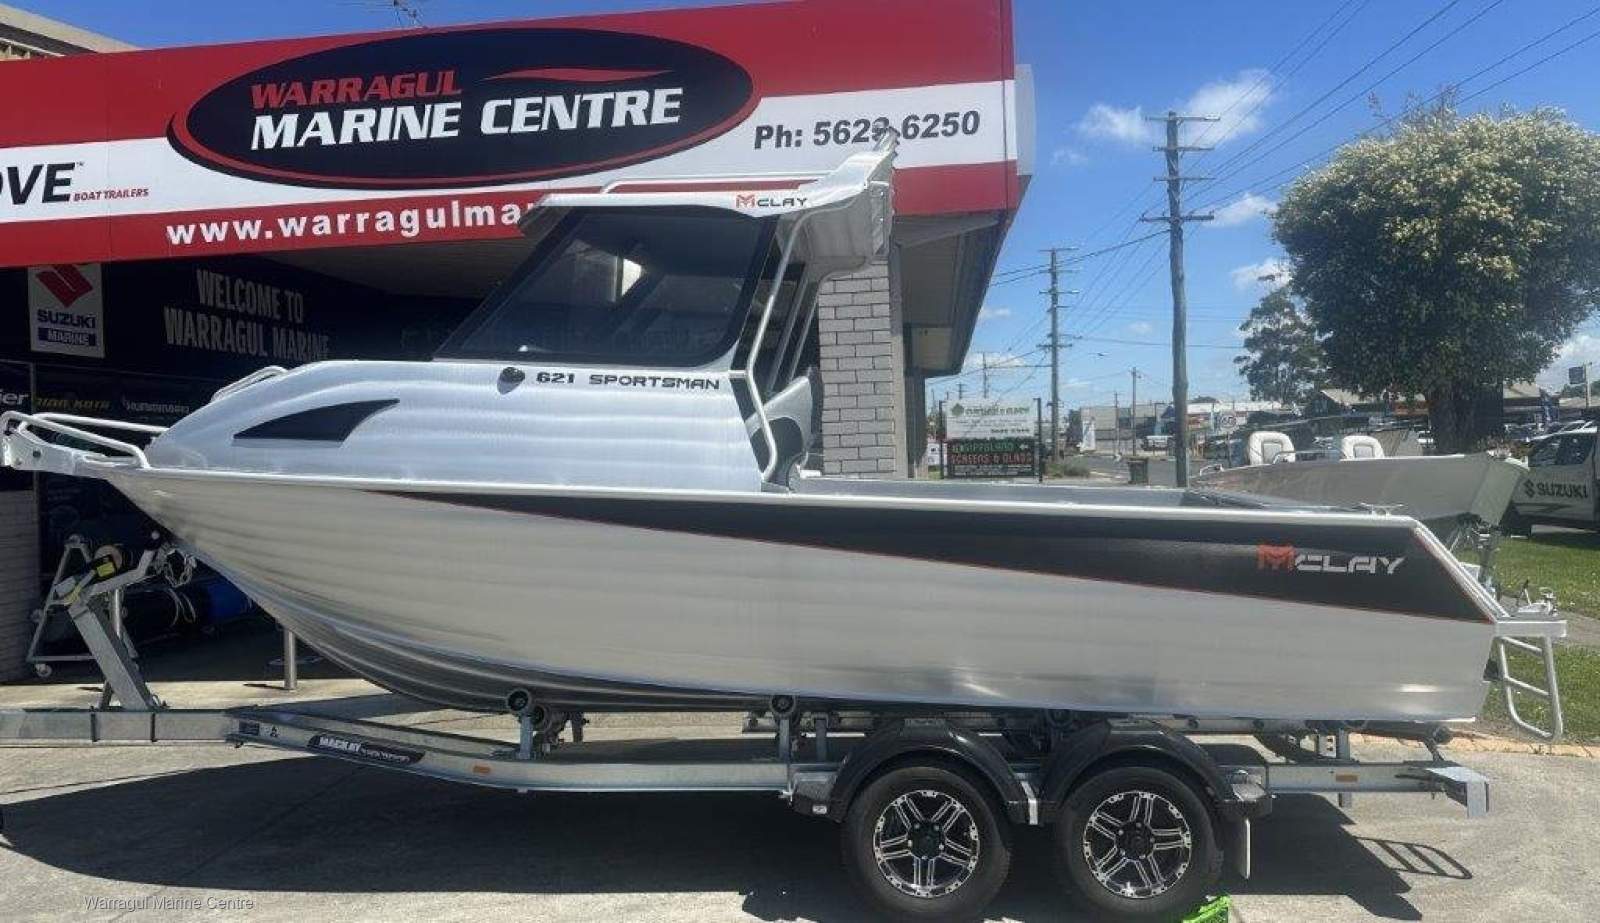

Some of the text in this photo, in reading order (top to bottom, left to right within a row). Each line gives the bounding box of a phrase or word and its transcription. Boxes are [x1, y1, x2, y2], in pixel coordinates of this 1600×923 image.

[250, 70, 463, 109] WARRAGUL
[251, 87, 683, 150] MARINE CENTRE
[754, 123, 803, 150] Ph:
[902, 110, 981, 140] 6250
[0, 162, 75, 205] VE
[74, 188, 149, 201] BOAT TRAILERS
[166, 200, 534, 245] www.warragulma
[196, 268, 304, 323] WELCOME TO
[37, 309, 96, 328] SUZUKI
[47, 330, 91, 344] MARINE
[163, 306, 330, 362] WARRAGUL MARINE
[536, 371, 720, 390] 621 SPORTSMAN
[1537, 482, 1589, 499] SUZUKI
